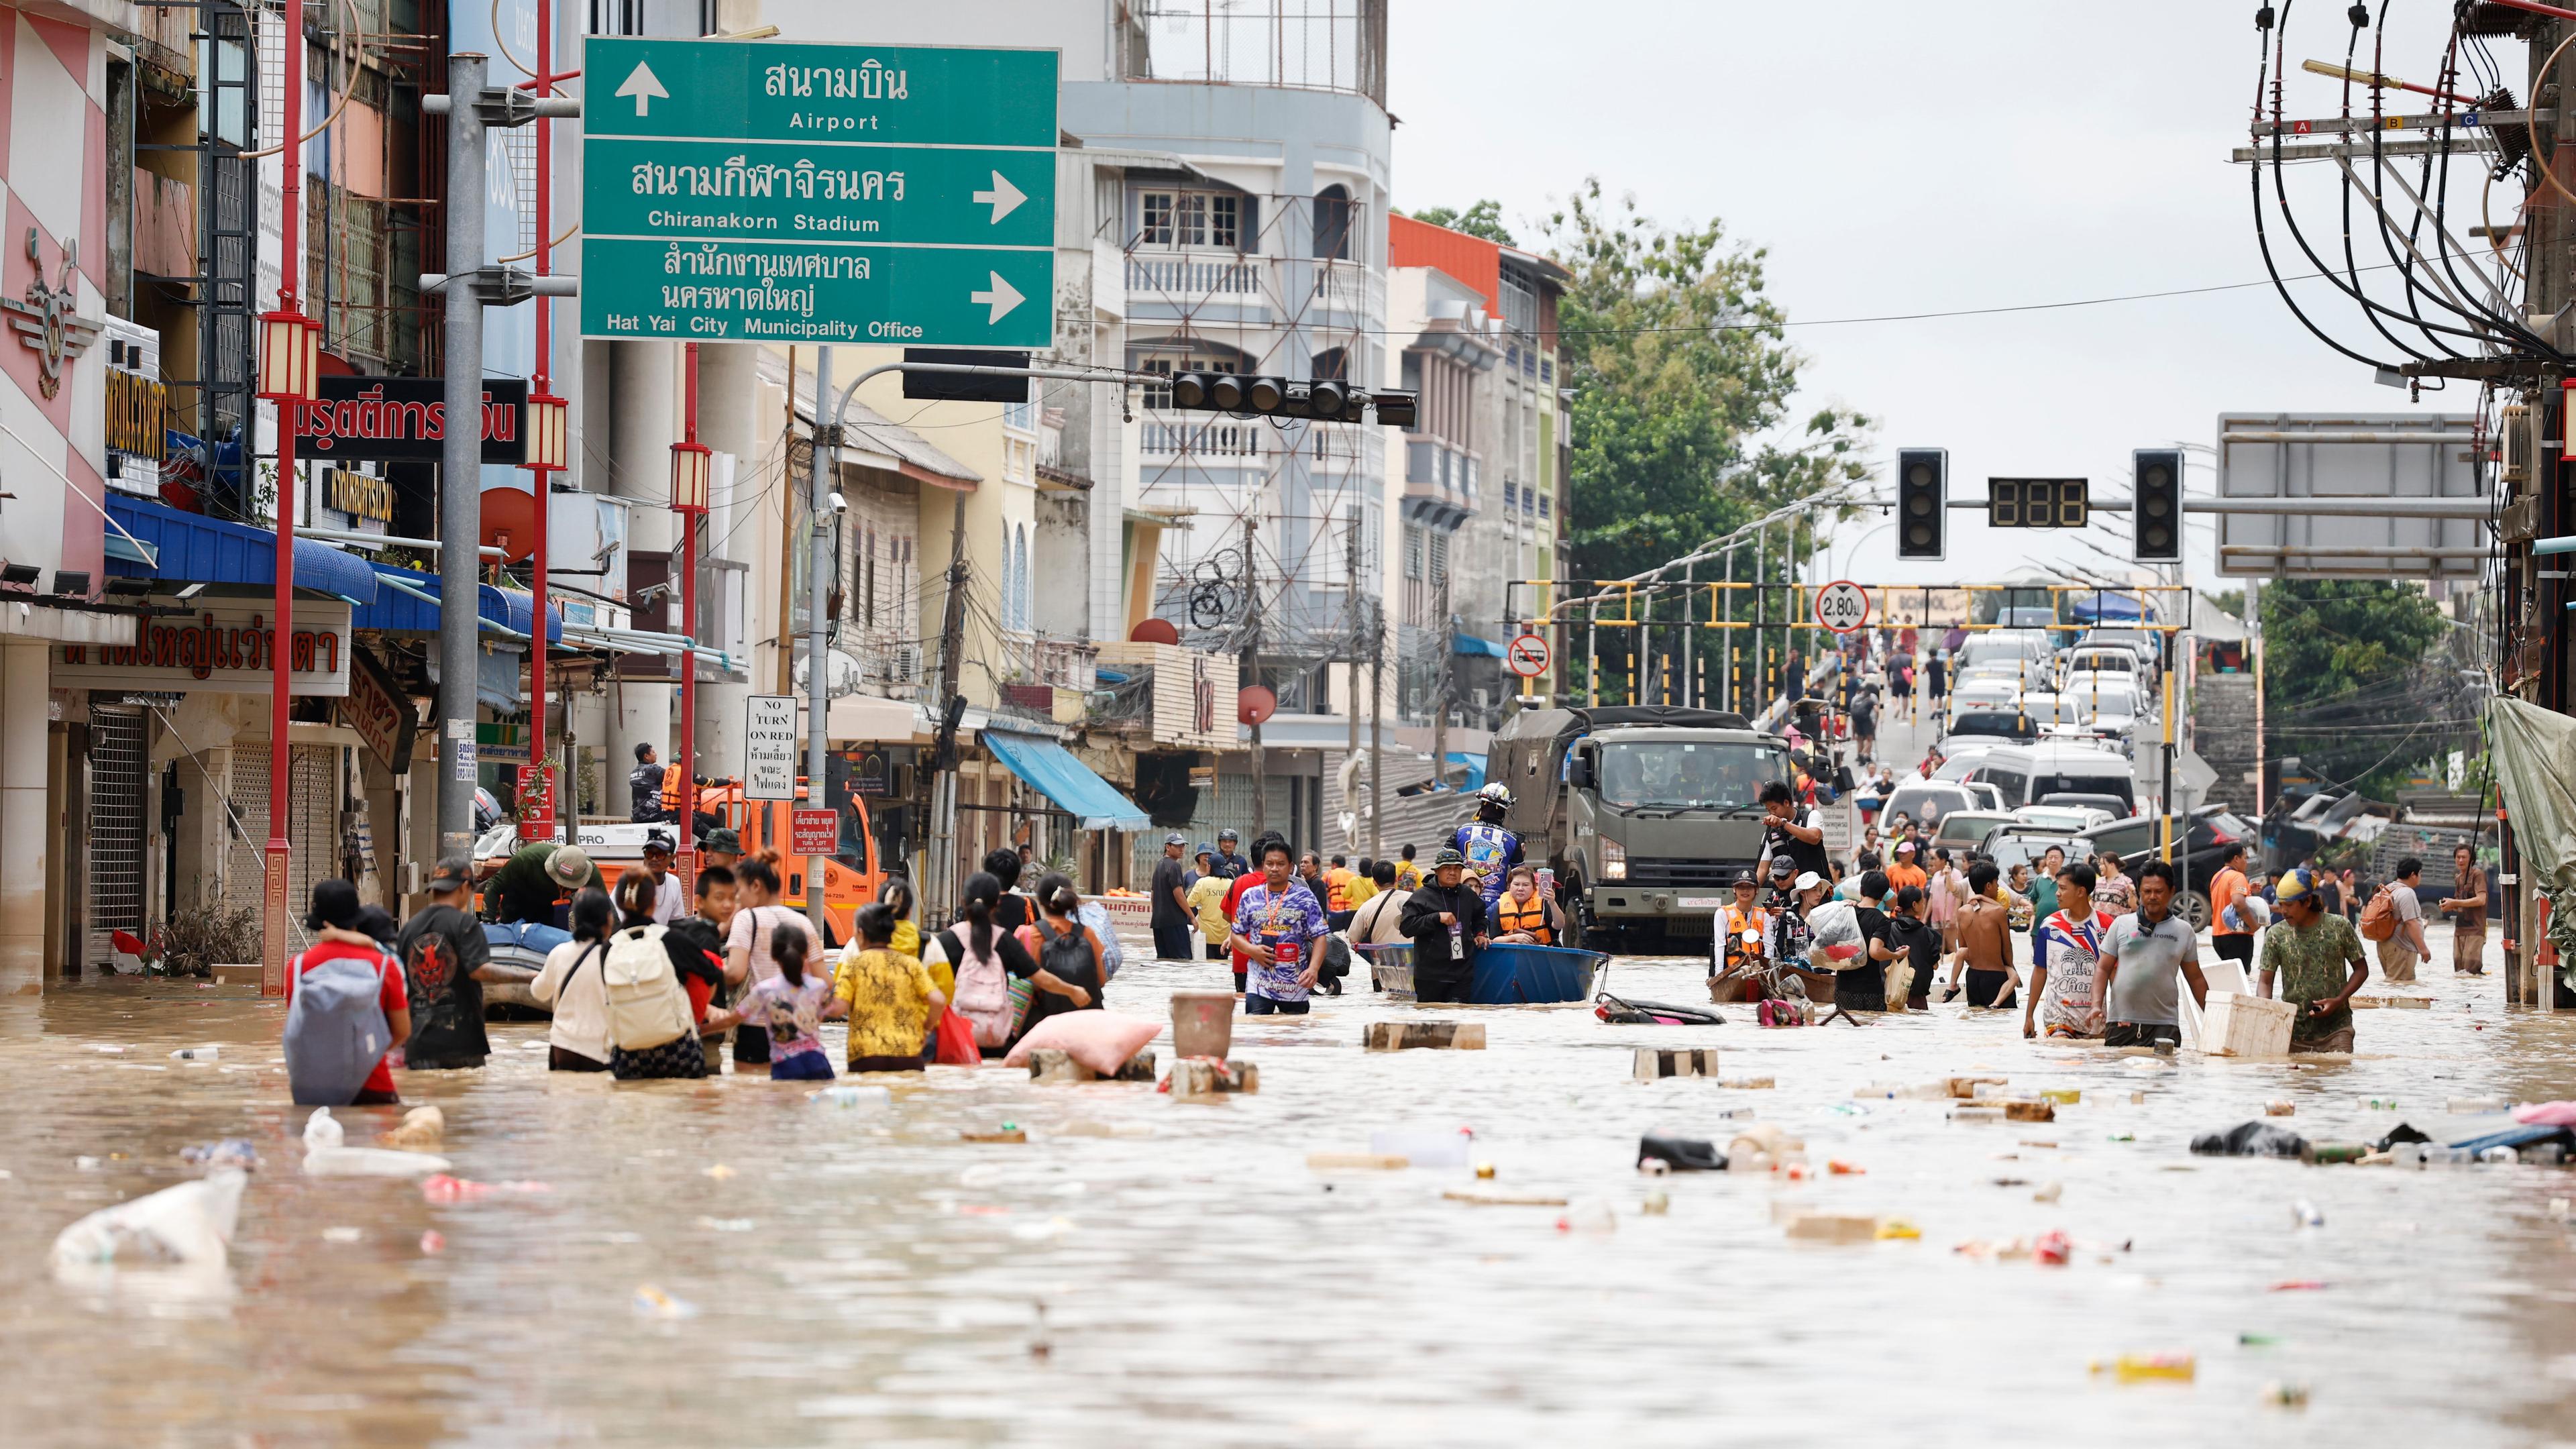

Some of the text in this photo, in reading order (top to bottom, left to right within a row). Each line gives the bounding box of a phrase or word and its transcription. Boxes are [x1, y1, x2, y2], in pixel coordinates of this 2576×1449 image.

[765, 58, 908, 100] สนามบิน
[790, 113, 878, 132] Airport
[2299, 123, 2307, 131] A
[2390, 119, 2398, 127] B
[2465, 116, 2473, 125] C
[632, 154, 904, 201] สนามกีฬาจิรนคร
[648, 210, 879, 232] Chiranakorn Stadium
[664, 242, 870, 280] สำนักงานเทศบาล
[661, 277, 814, 319] นครหาดใหญ่
[607, 314, 923, 339] Hat Yai City Municipality Office
[1823, 596, 1853, 616] 2.80
[765, 701, 781, 710] NO
[758, 715, 788, 725] TURN
[750, 731, 793, 741] ON RED
[751, 745, 792, 761] ห้ามเลี้ยว
[760, 765, 781, 774] ขณะ
[755, 774, 786, 790] ไฟแดง
[795, 812, 833, 828] เลี้ยวซ้าย หยุด
[578, 835, 604, 845] PRO
